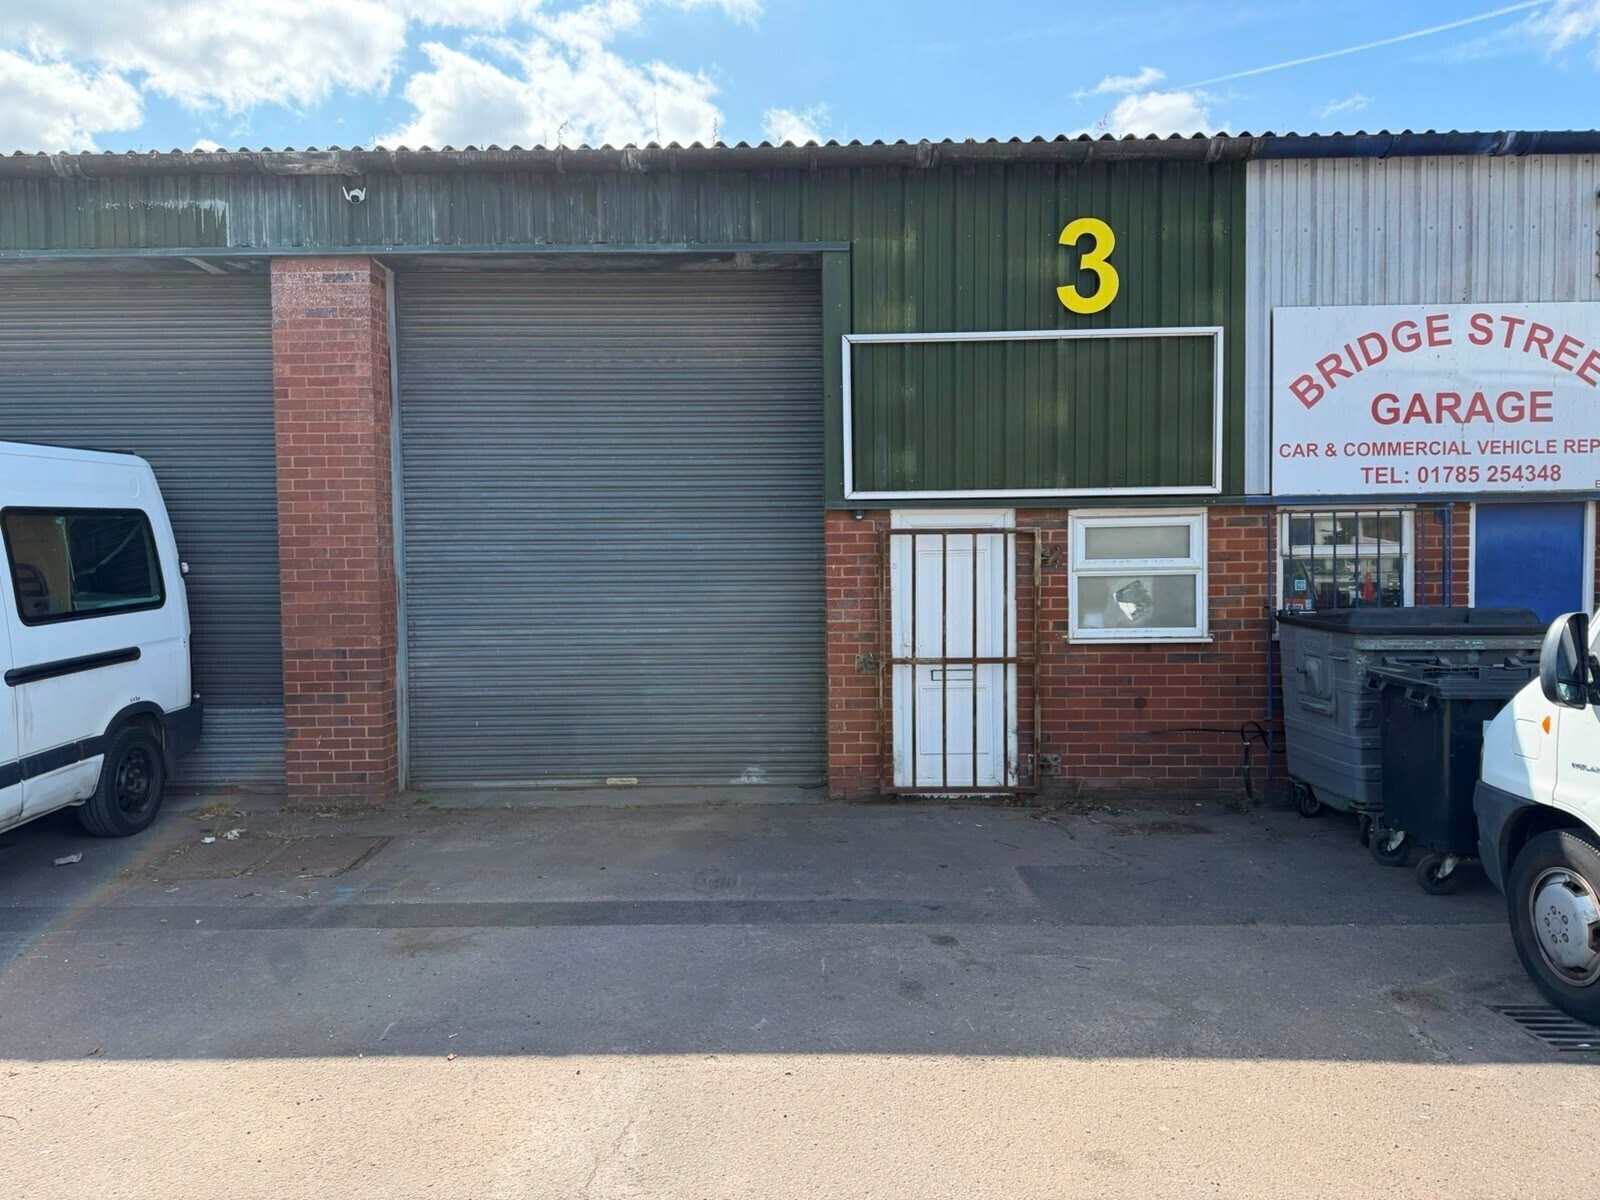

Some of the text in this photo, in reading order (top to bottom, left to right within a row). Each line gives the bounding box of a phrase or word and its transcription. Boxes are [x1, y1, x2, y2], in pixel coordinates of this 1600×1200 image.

[1057, 217, 1119, 314] 3
[1289, 313, 1600, 410] BRIDGE STREE
[1371, 391, 1553, 425] GARAGE
[1280, 439, 1600, 458] CAR & COMMERCIAL VEHICLE REP
[1360, 465, 1561, 484] TEL: 01785 254348
